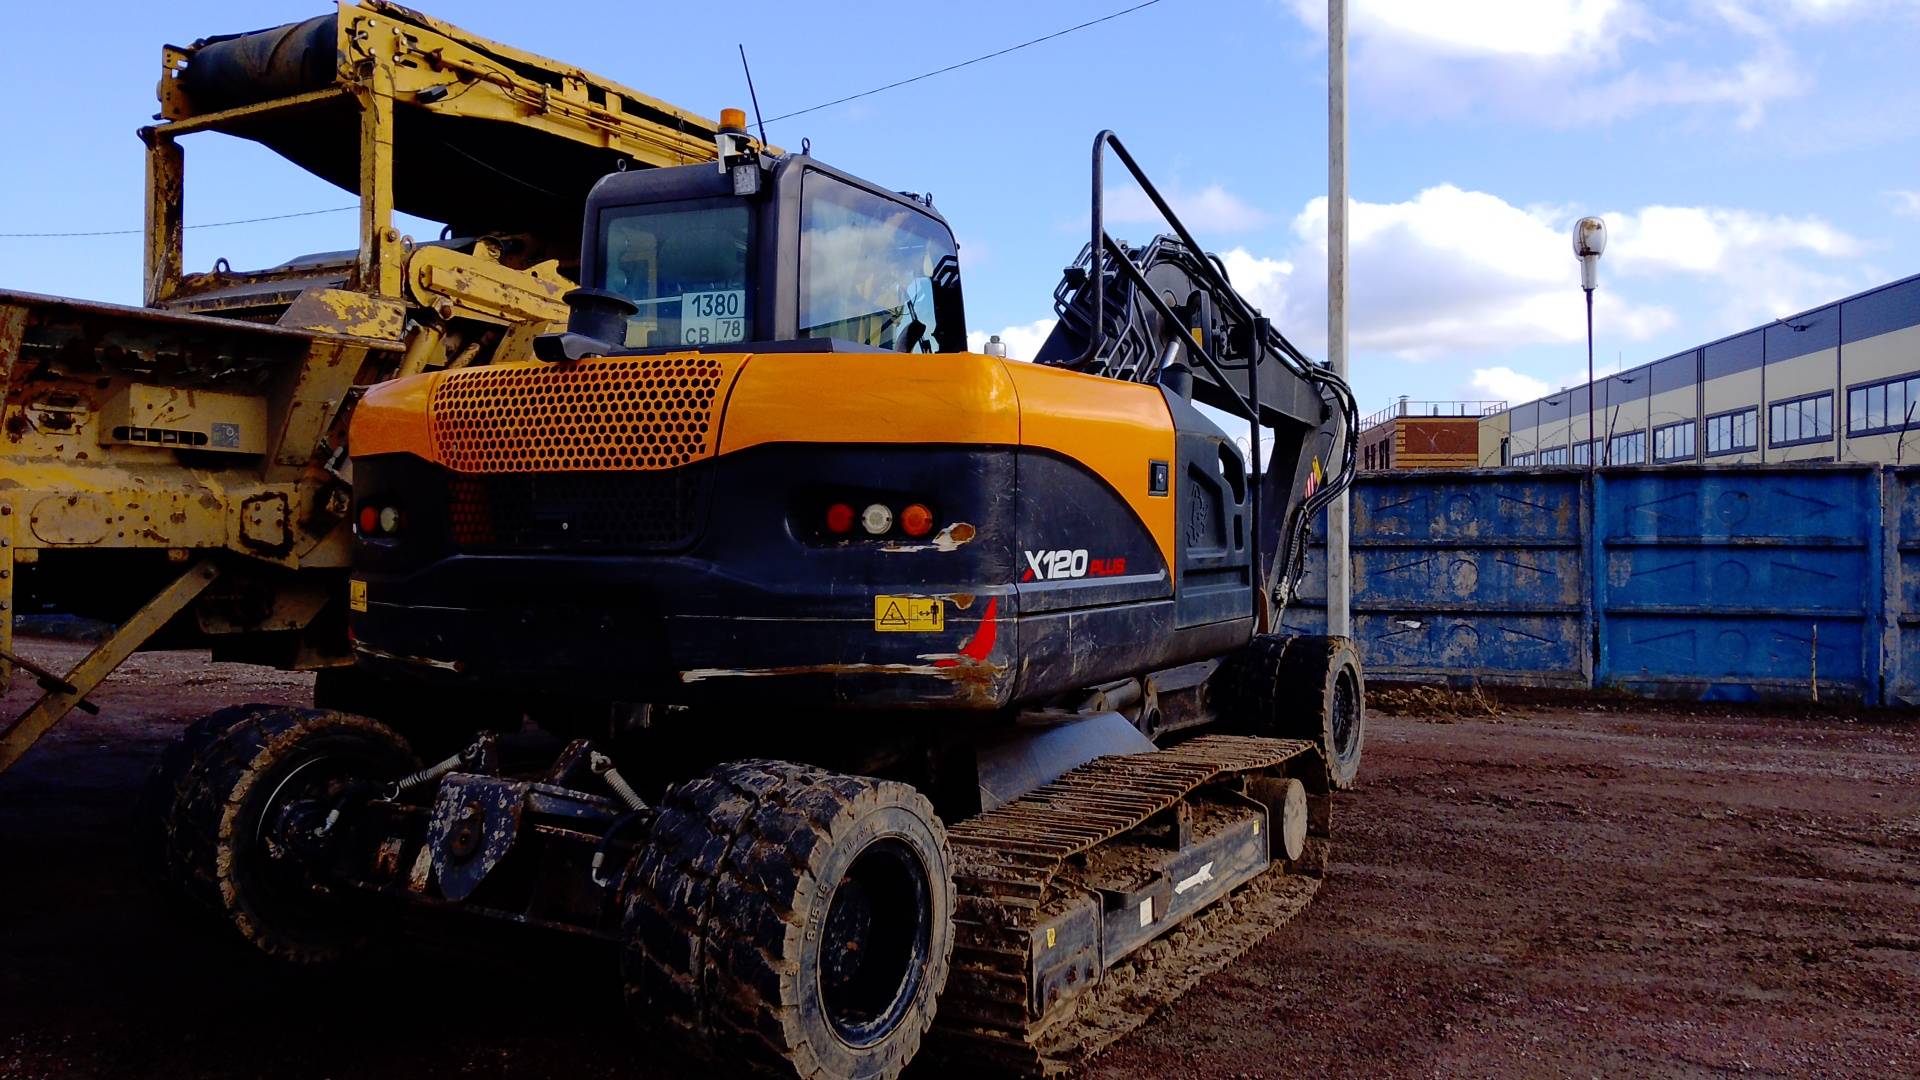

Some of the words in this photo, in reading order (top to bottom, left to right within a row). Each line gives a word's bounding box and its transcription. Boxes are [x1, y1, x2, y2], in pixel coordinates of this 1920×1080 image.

[691, 292, 739, 317] 1380
[722, 319, 741, 338] 78
[1022, 549, 1089, 581] X120
[1088, 557, 1127, 576] PLUS
